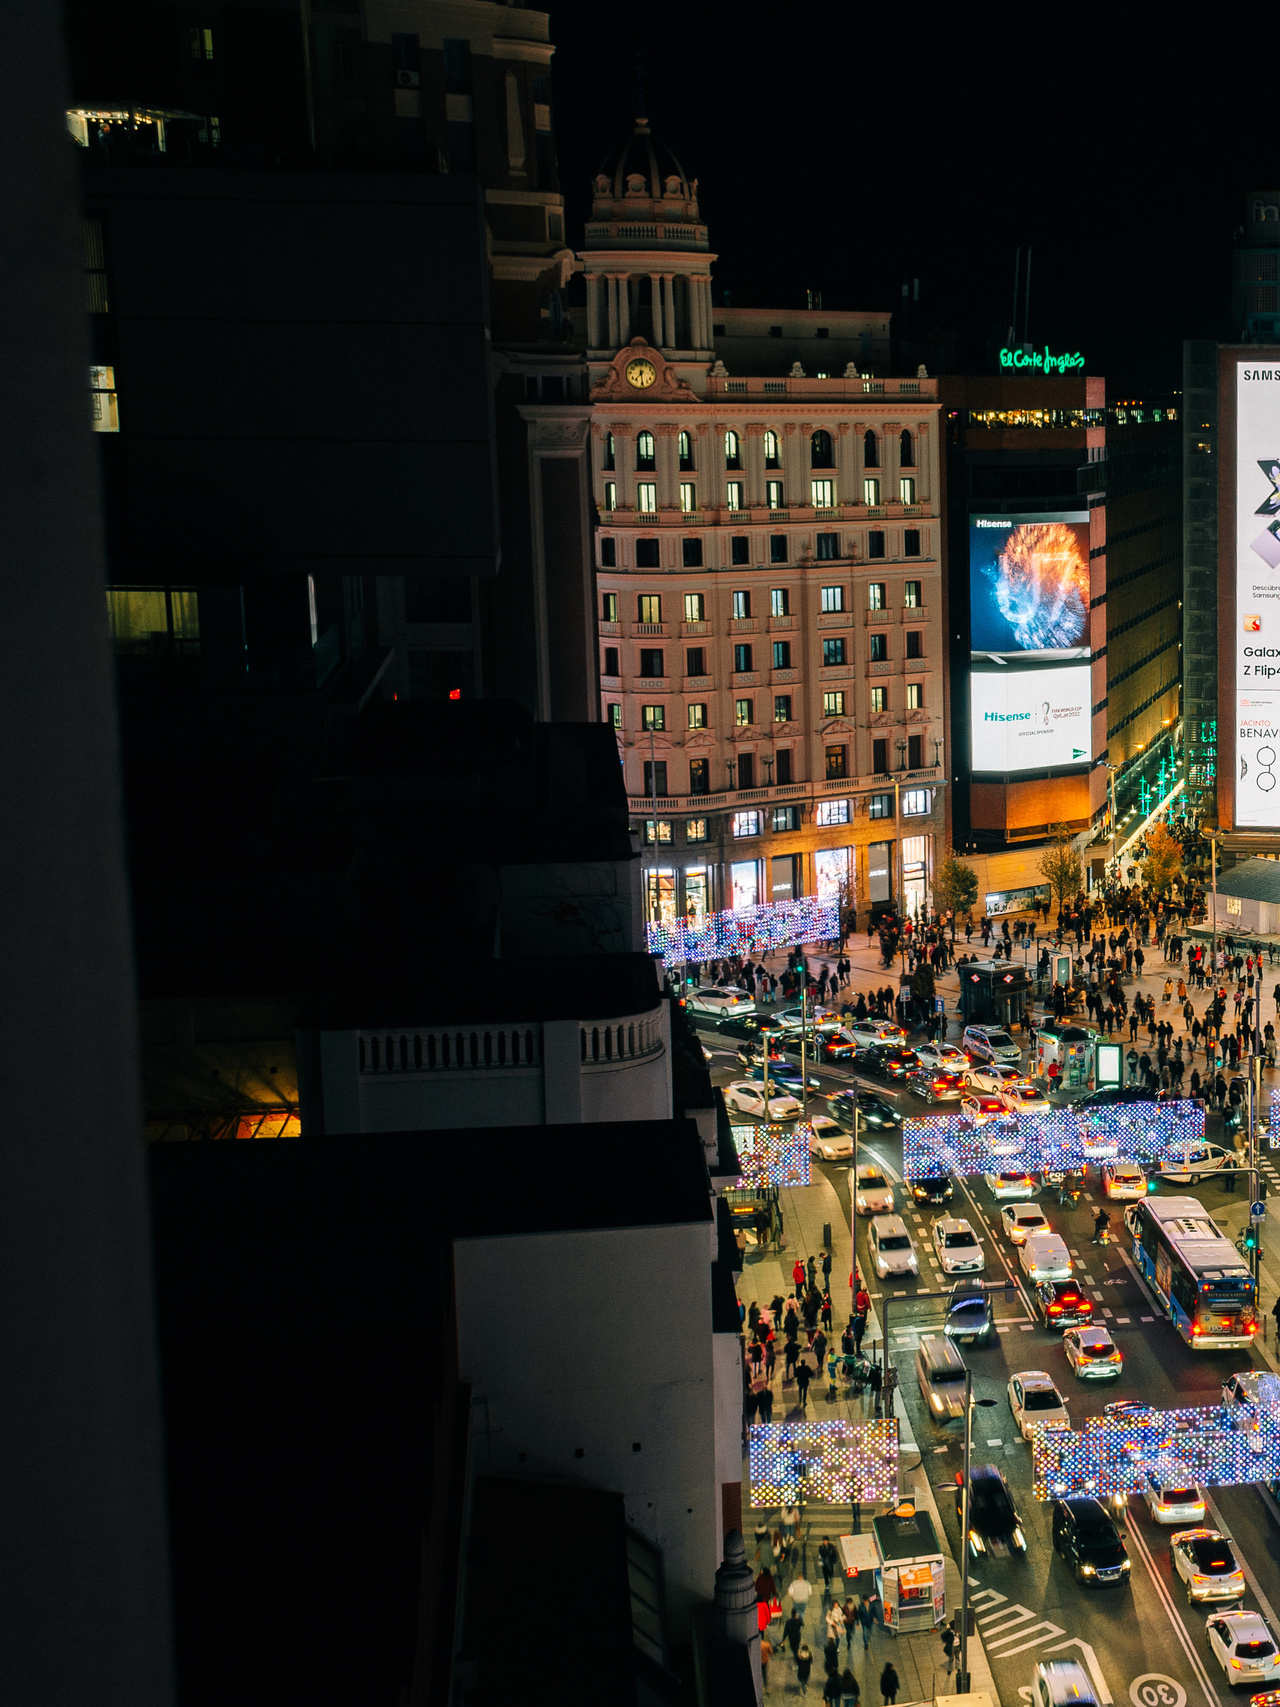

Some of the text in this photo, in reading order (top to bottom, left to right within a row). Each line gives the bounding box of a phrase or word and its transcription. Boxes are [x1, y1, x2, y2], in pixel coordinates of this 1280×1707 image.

[1000, 345, 1085, 374] El Corte Inglés
[976, 519, 1012, 528] Hisense
[1243, 665, 1251, 676] Z
[984, 711, 1031, 722] Hisense
[1142, 1684, 1175, 1707] 30
